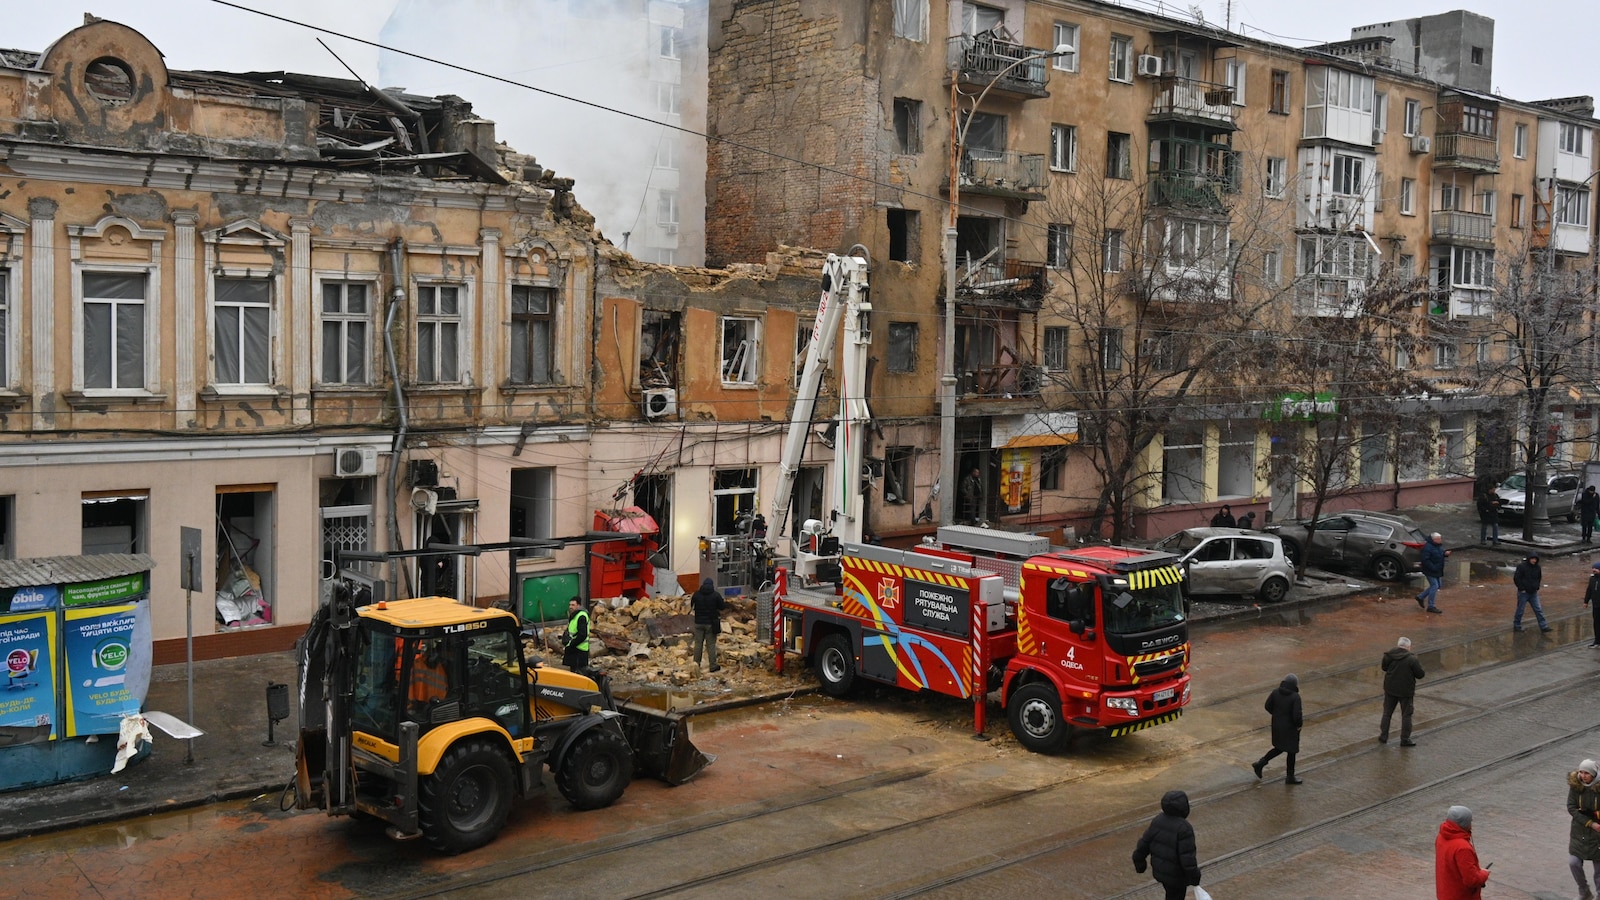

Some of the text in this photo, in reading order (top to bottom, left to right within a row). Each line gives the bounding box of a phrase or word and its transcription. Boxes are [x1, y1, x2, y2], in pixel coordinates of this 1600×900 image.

[919, 589, 954, 604] ПОЖЕЖНО
[914, 597, 958, 614] РЯТУВАЛЬНА
[922, 608, 951, 622] СЛУЖБА
[11, 632, 40, 642] НАРАДИ
[1141, 634, 1179, 649] DAEWOO
[101, 650, 126, 660] VELO
[1066, 646, 1075, 661] 4
[1060, 659, 1084, 671] ОДЕСА
[89, 691, 108, 700] VELO
